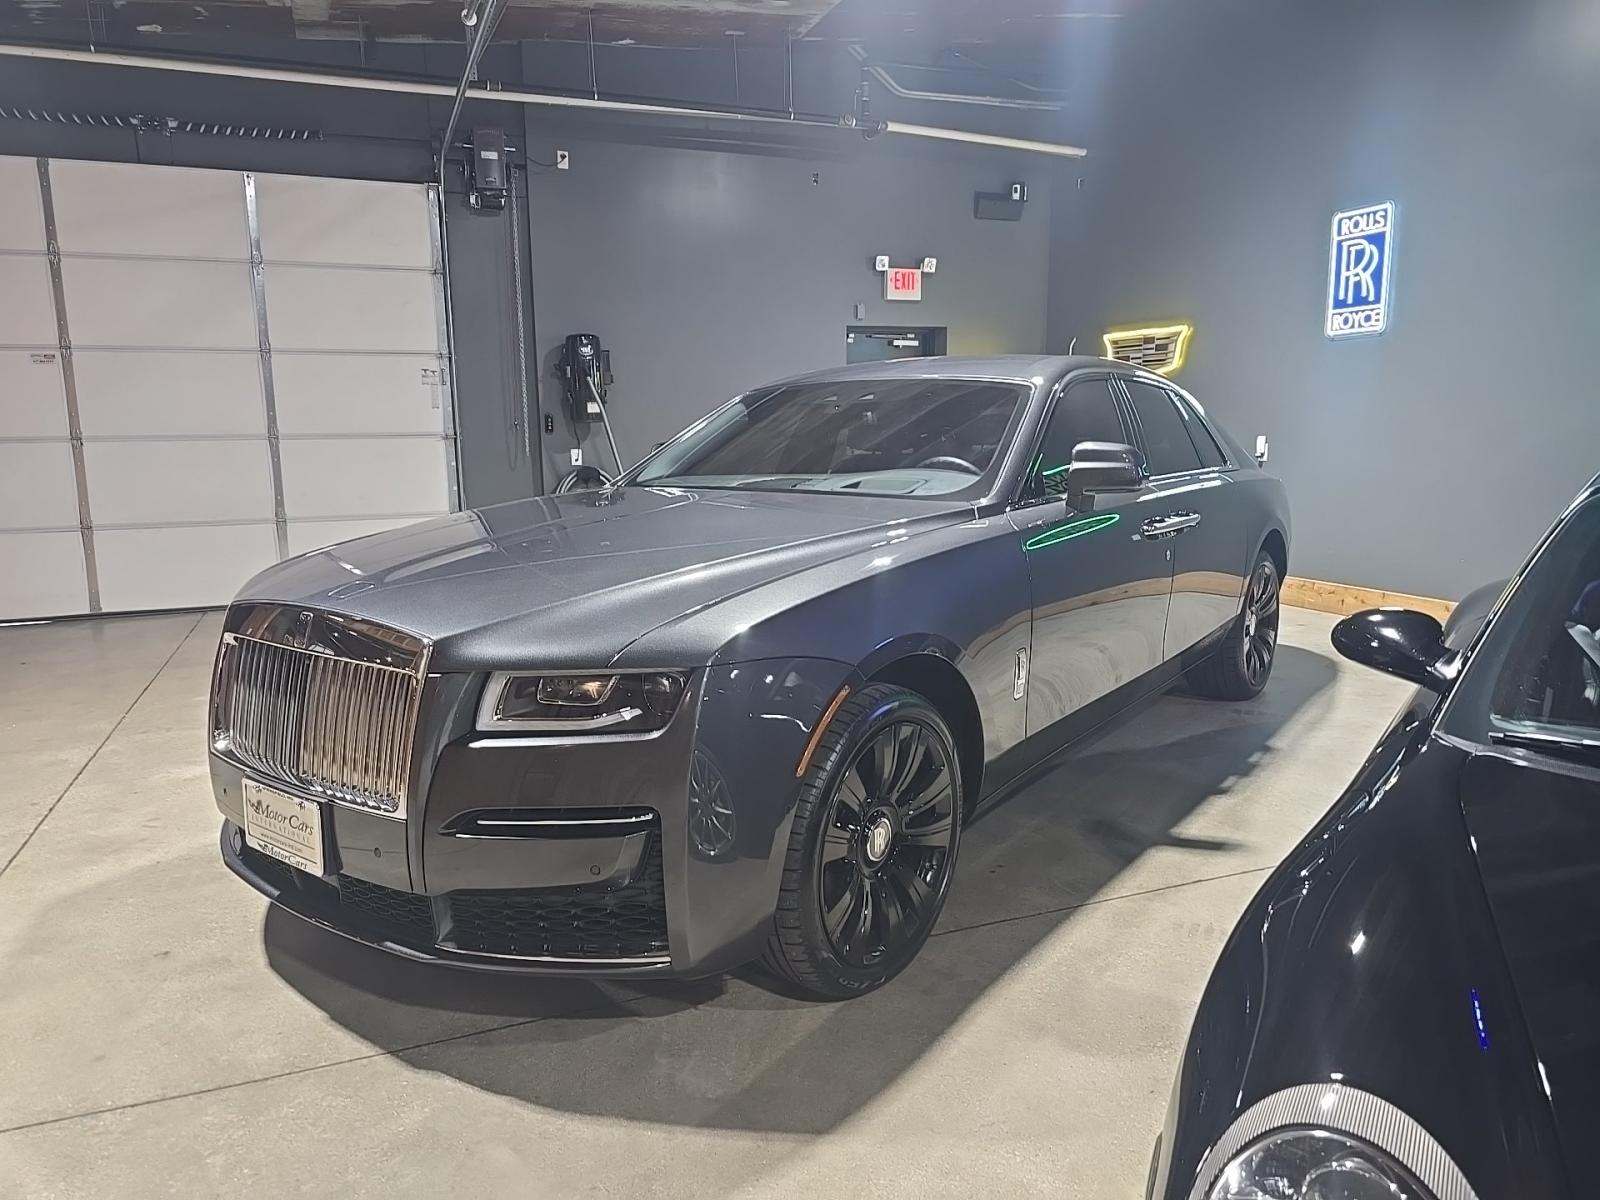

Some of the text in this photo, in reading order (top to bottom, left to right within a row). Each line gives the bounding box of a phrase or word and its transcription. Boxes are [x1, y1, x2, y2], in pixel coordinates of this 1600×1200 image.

[1341, 210, 1386, 235] ROLLS
[894, 271, 916, 290] EXIT
[1332, 308, 1382, 331] ROYCE
